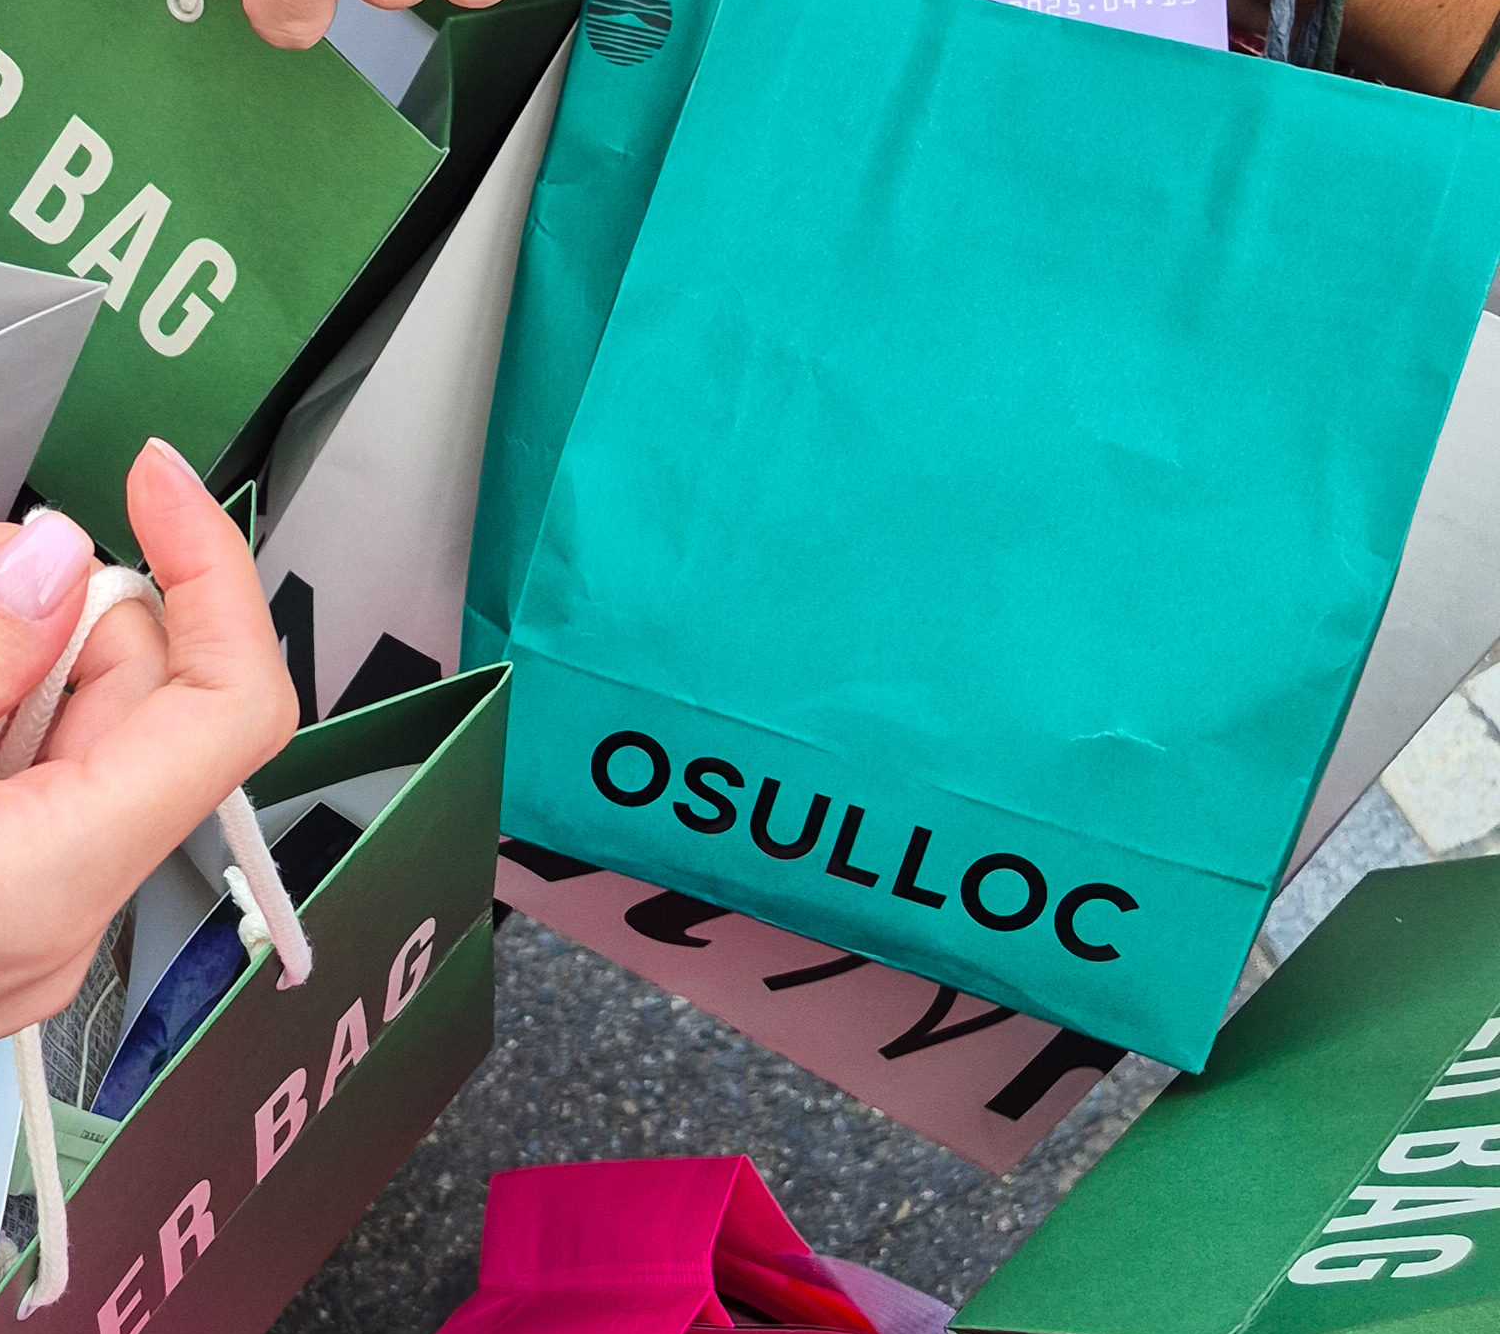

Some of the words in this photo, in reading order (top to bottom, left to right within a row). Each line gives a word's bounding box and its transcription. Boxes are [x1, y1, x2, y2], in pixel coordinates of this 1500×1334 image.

[9, 114, 237, 357] BAG
[590, 731, 1140, 963] OSULLOC
[254, 917, 437, 1185] BAG
[1287, 1124, 1500, 1285] BAG
